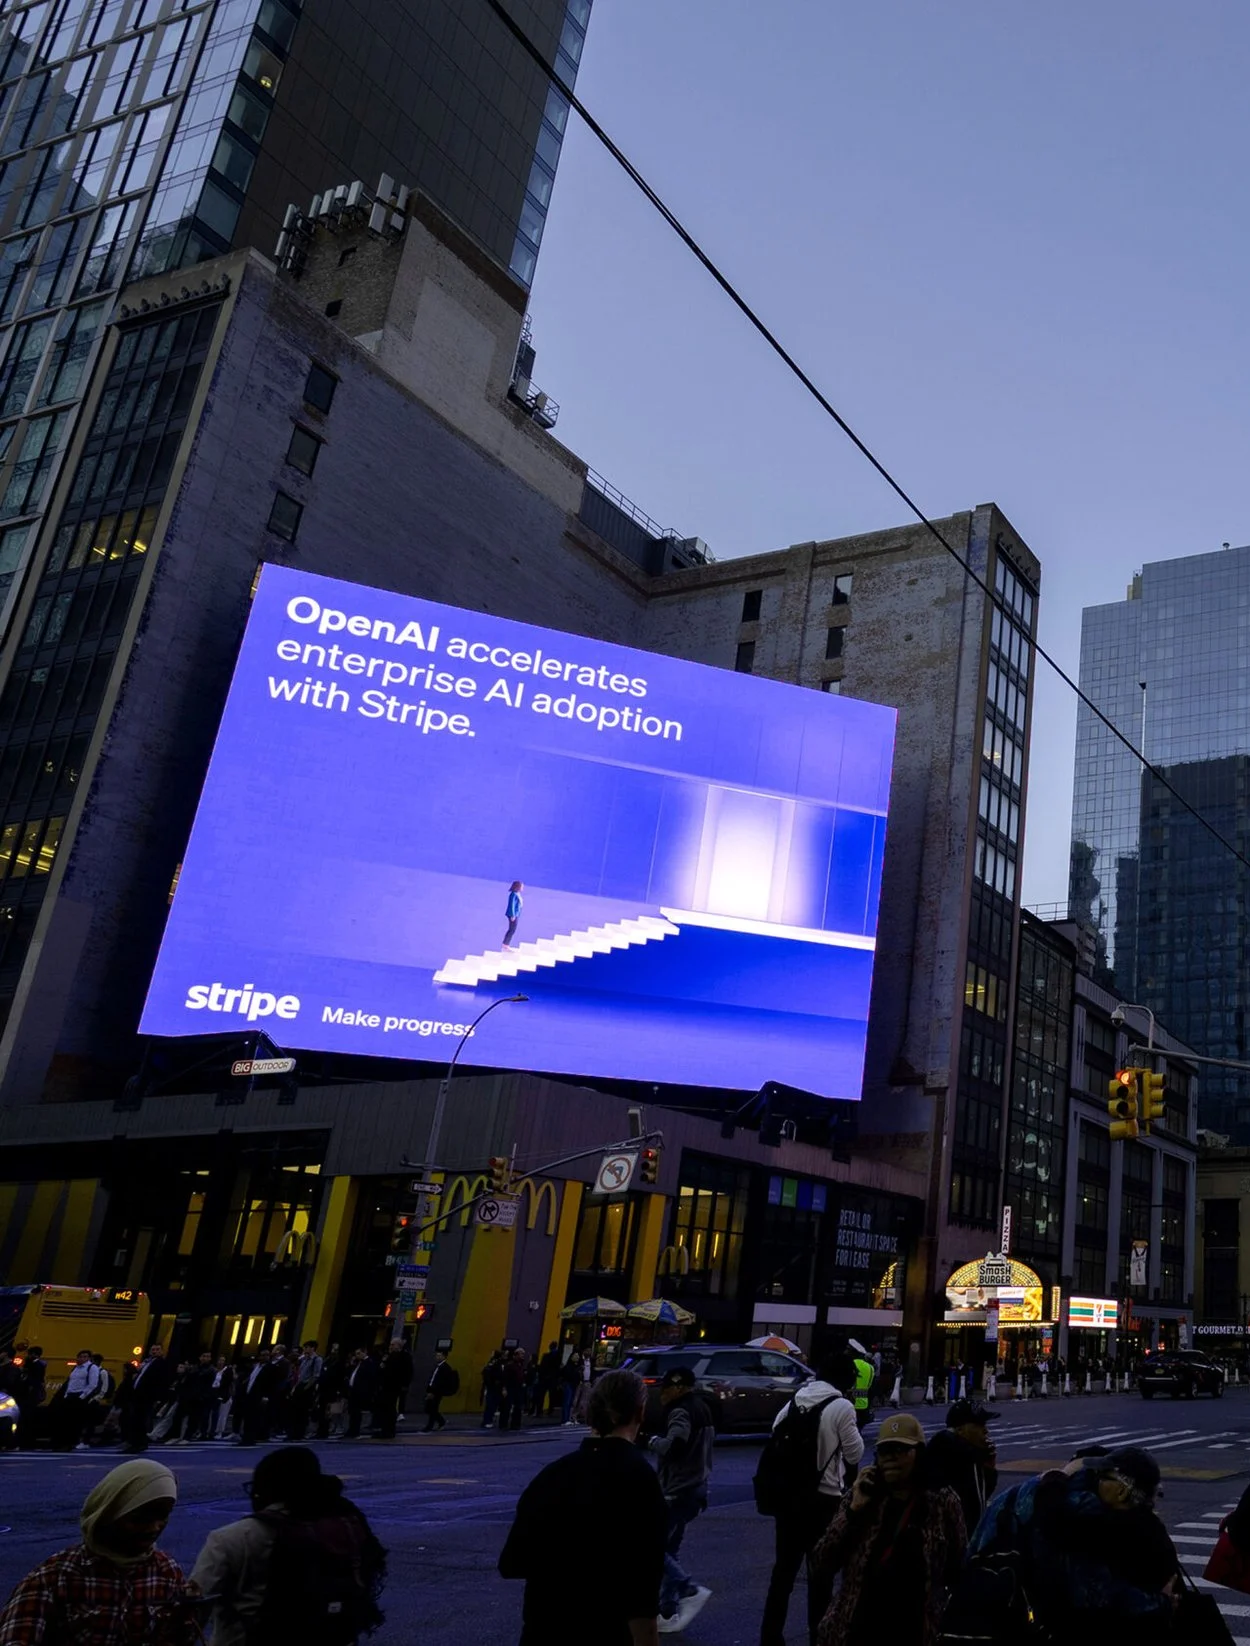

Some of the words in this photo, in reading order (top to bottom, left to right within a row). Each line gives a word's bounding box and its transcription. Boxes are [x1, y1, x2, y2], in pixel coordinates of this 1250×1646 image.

[286, 597, 440, 652] OpenAI
[446, 638, 648, 698] accelerates
[268, 677, 350, 712] with
[358, 690, 476, 737] Stripe.
[277, 640, 477, 698] enterprise
[484, 679, 524, 708] AI
[532, 694, 683, 741] adoption
[185, 983, 300, 1020] stripe
[322, 1007, 380, 1028] Make
[384, 1017, 475, 1037] progress
[234, 1063, 251, 1072] BIG
[252, 1062, 289, 1071] OUTDOOR
[1002, 1208, 1010, 1251] PIZZA
[980, 1275, 1011, 1284] BURGER
[606, 1326, 622, 1337] DOG
[1198, 1325, 1236, 1335] GOURMET
